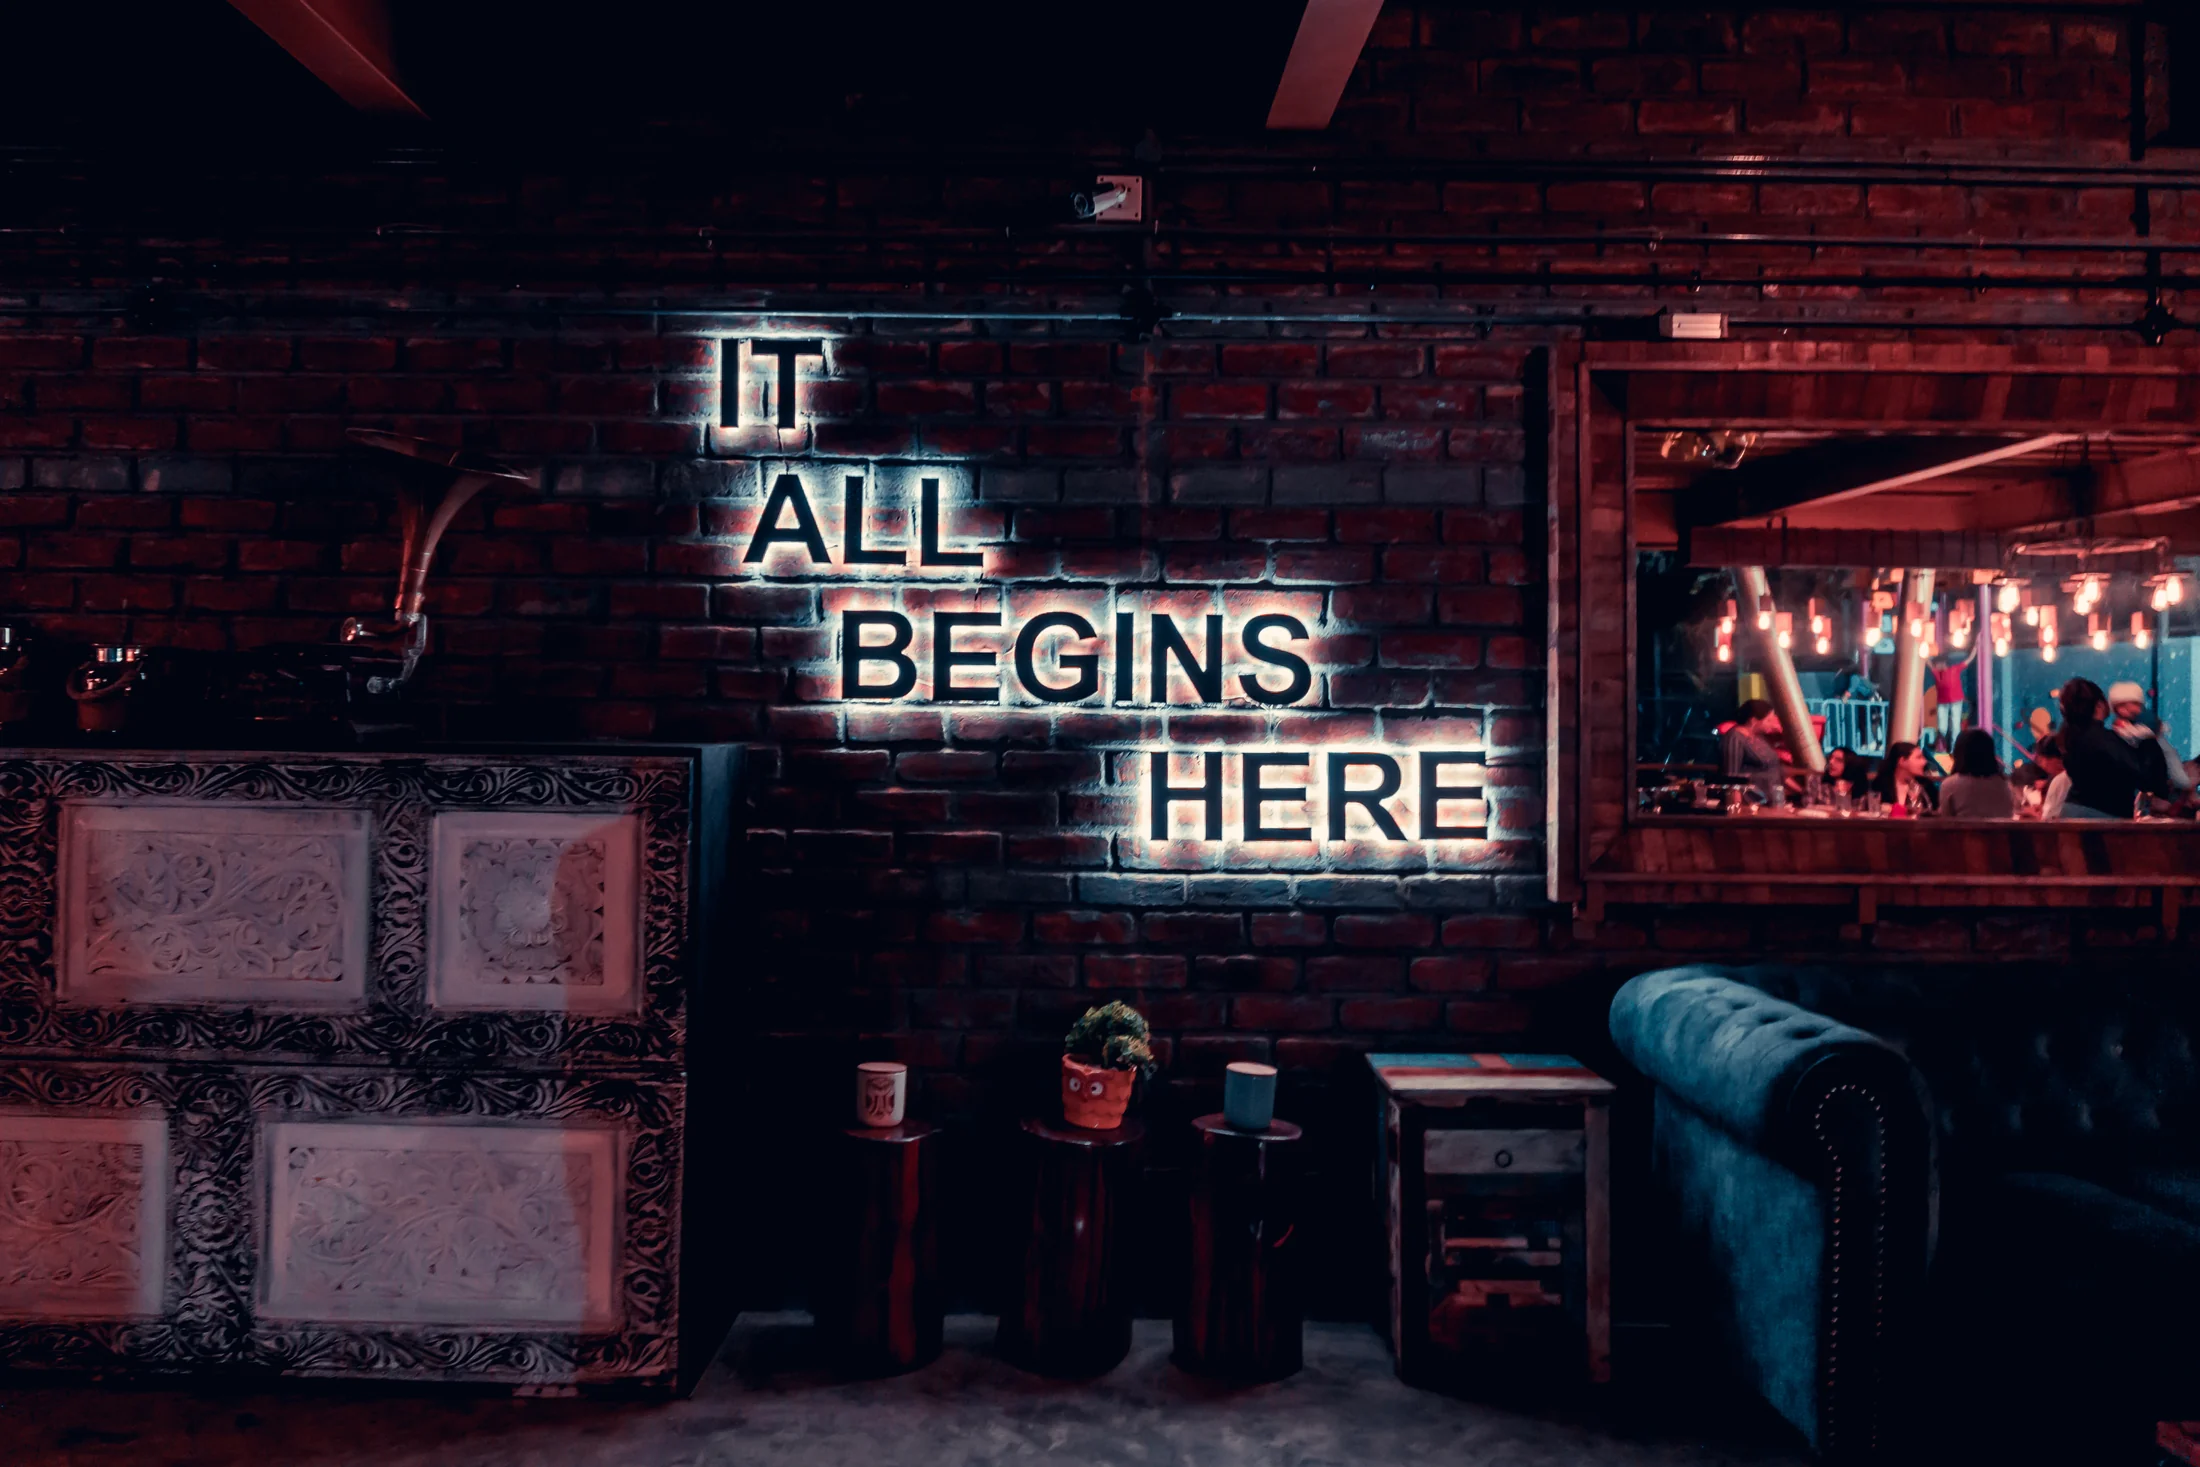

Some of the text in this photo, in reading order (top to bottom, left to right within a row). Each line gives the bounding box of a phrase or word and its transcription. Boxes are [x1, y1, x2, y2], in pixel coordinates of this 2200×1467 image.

[718, 338, 824, 430] IT
[743, 473, 984, 567] ALL
[841, 608, 1313, 705] BEGINS
[1150, 750, 1489, 842] HERE
